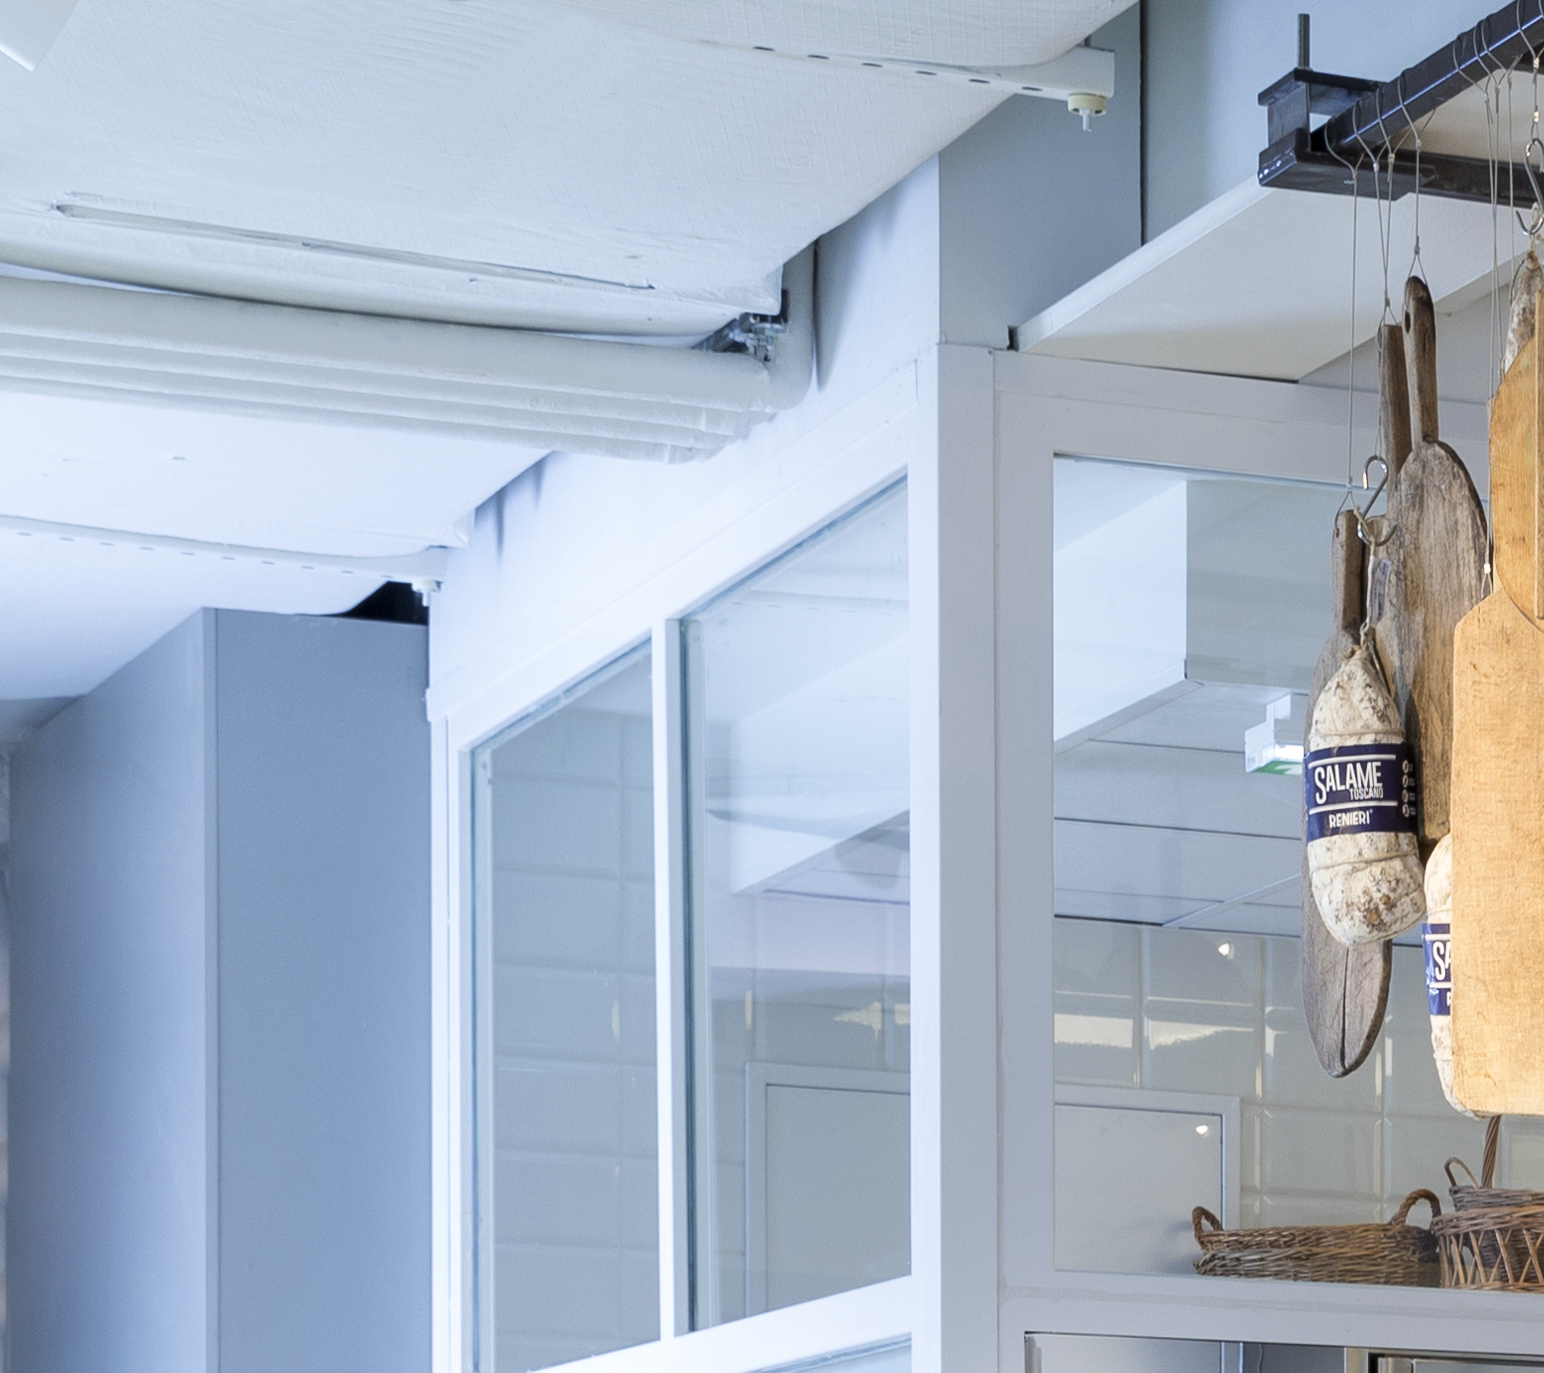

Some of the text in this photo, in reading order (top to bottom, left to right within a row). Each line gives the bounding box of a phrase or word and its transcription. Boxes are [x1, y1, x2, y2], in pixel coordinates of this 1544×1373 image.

[1315, 762, 1383, 804] SALAME
[1350, 787, 1384, 800] TOSCANO
[1329, 811, 1370, 828] RENIERI
